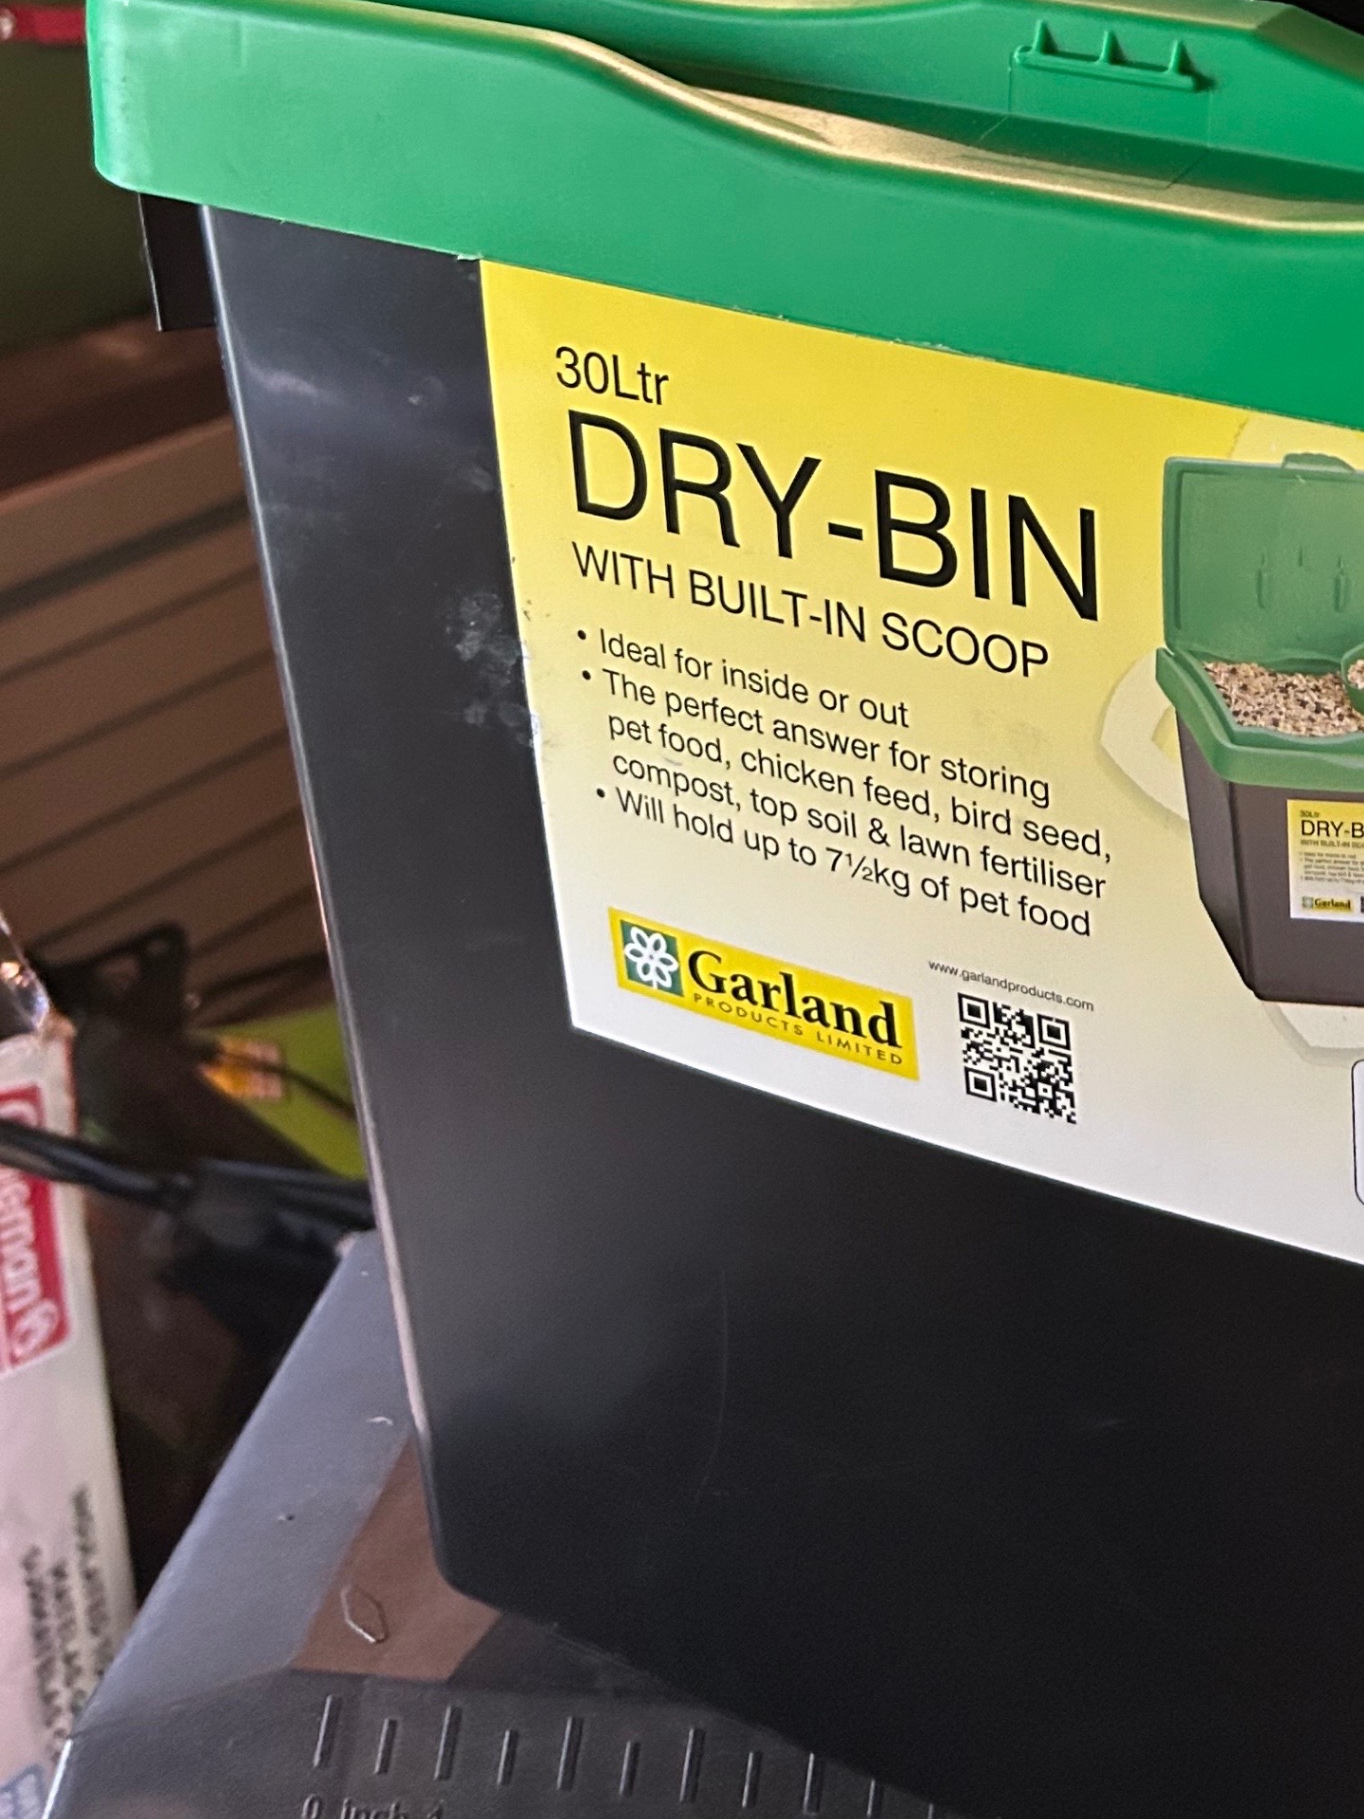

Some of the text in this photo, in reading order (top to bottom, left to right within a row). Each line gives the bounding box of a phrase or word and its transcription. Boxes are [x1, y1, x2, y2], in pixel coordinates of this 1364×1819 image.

[555, 345, 670, 406] 30Ltr
[567, 408, 1099, 623] DRY-BIN
[571, 540, 1049, 678] WITH BUILT-IN SCOOP
[599, 627, 910, 729] Ideal for inside or out
[601, 667, 1050, 810] The perfect answer for storing
[608, 714, 1111, 864] pet food, chicken feed, bird seed,
[612, 754, 1107, 899] compost, top soil & lawn fertiliser
[615, 786, 665, 824] Will
[672, 803, 734, 844] hold
[743, 829, 780, 861] up
[787, 837, 817, 867] to
[920, 875, 950, 902] of
[959, 886, 1010, 918] pet
[1017, 894, 1091, 937] food
[1314, 897, 1351, 910] Garland
[687, 950, 903, 1049] Garland
[693, 992, 903, 1065] PRODUCTS LIMITED
[928, 960, 1094, 1012] www.garlandproducts.com
